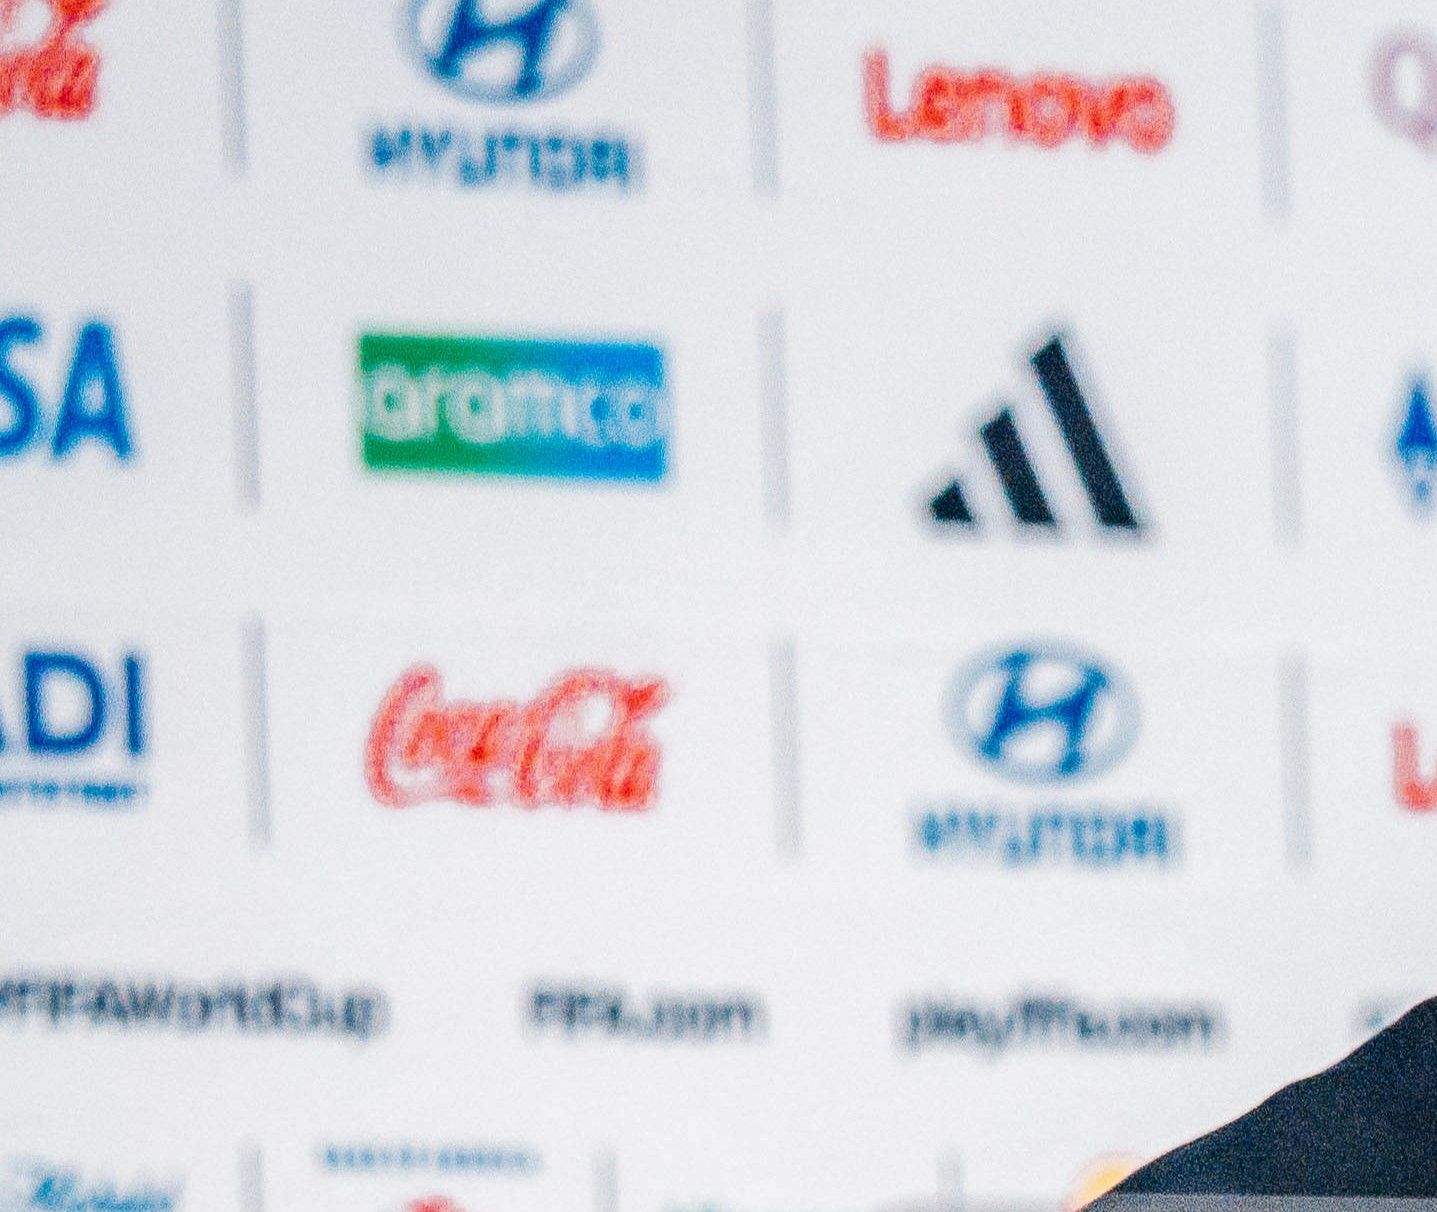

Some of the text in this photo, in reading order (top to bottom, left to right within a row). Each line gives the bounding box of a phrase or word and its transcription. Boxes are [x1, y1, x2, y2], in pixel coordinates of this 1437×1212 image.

[865, 48, 1175, 153] Lenovo
[365, 365, 662, 446] aramco
[367, 664, 668, 812] Coca-Cola
